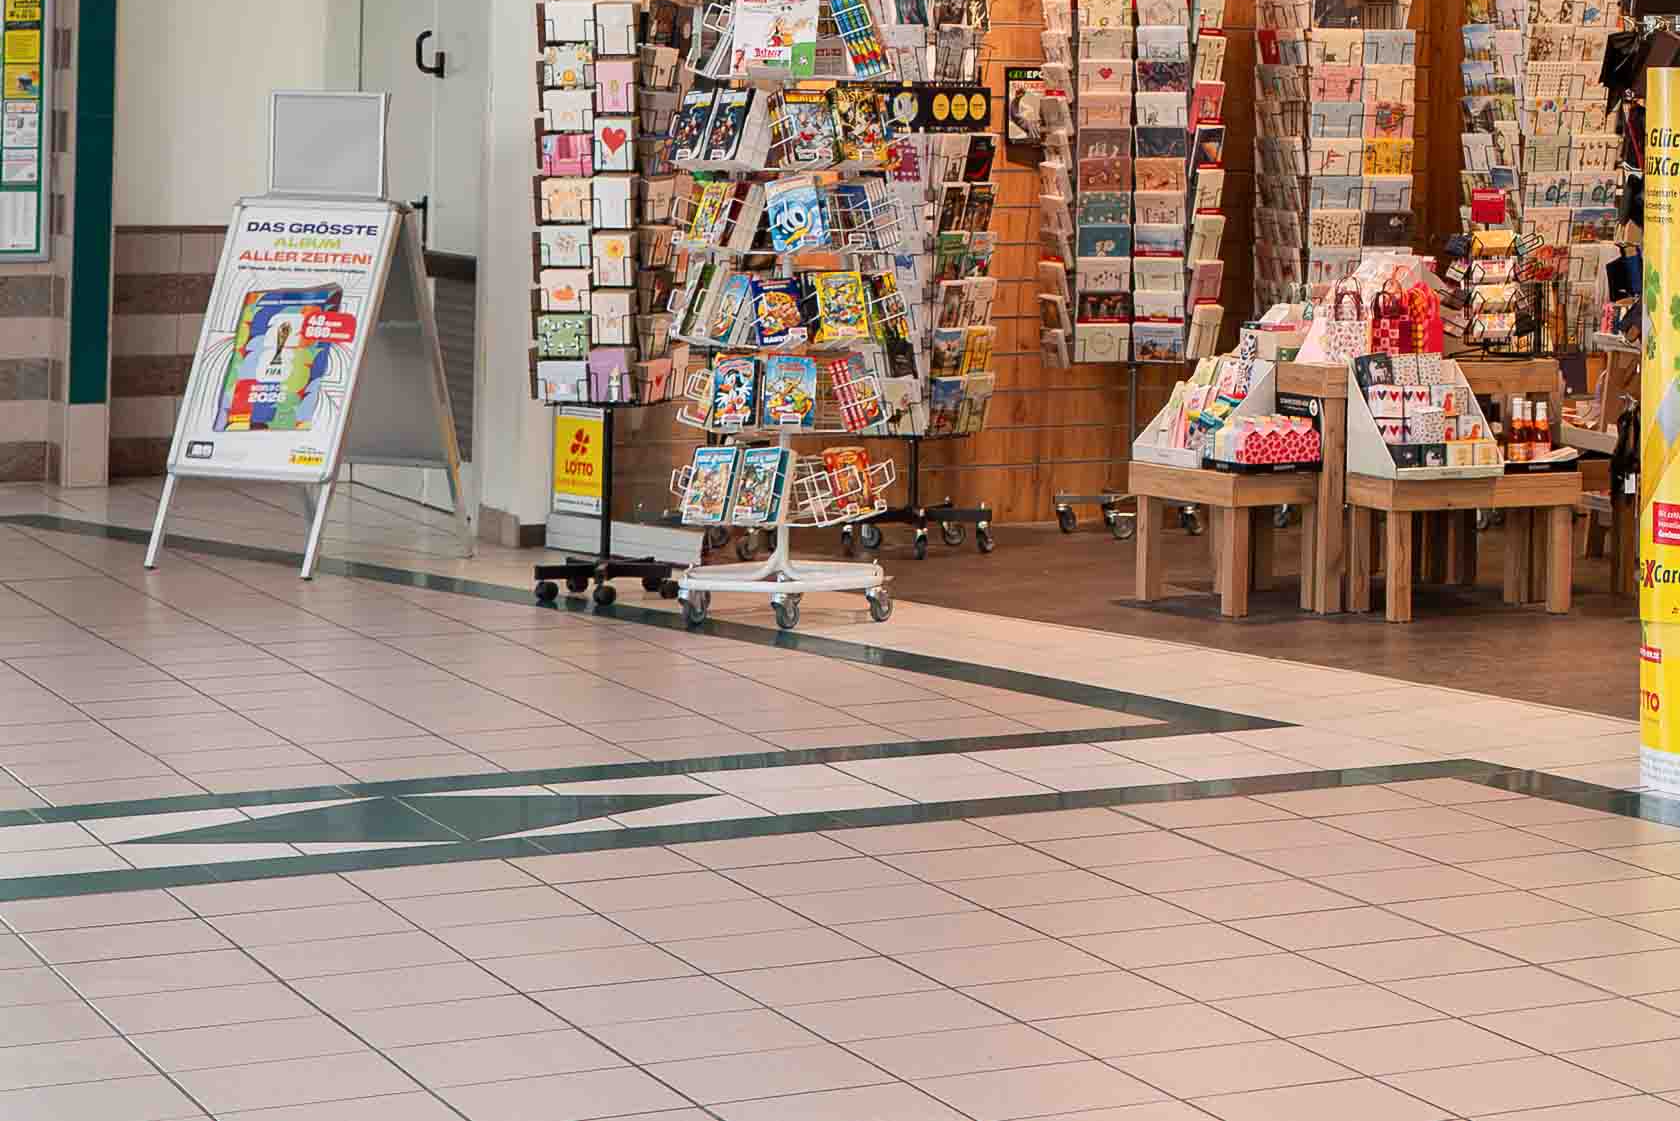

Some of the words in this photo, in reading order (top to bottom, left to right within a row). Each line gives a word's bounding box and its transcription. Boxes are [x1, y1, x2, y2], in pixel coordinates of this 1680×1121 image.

[247, 221, 286, 233] DAS
[288, 220, 379, 236] GRÖSSTE
[273, 238, 342, 250] ALBUM
[239, 249, 298, 263] ALLER
[301, 250, 373, 265] ZEITEN!
[247, 391, 288, 403] 2026
[565, 459, 593, 476] LOTTO
[1640, 690, 1660, 712] TTO
